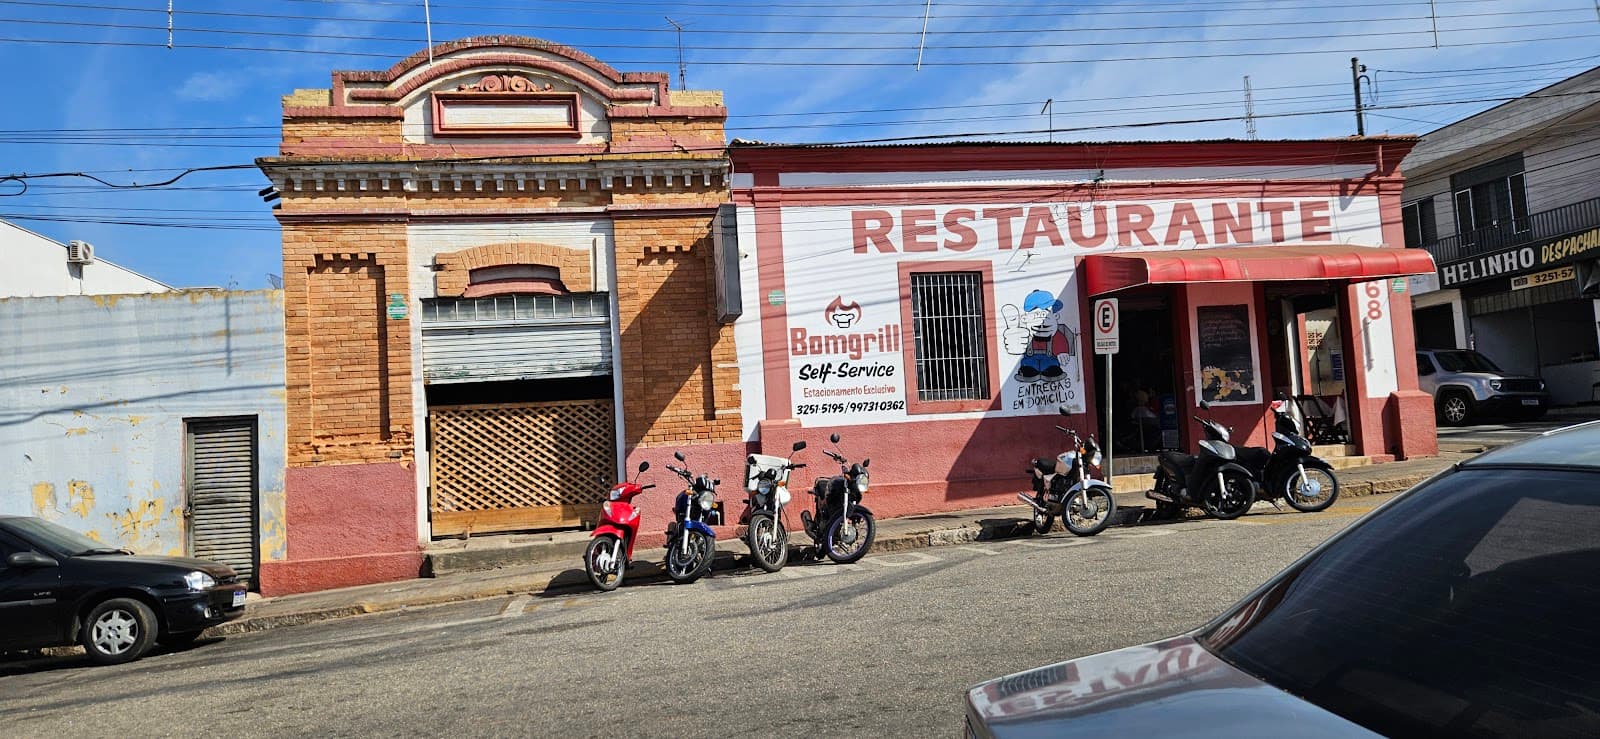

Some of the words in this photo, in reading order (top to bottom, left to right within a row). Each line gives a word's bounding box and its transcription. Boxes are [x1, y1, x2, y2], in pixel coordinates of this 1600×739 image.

[851, 201, 1332, 254] RESTAURANTE
[1442, 247, 1535, 286] HELINHO
[1102, 307, 1110, 328] E
[789, 324, 900, 360] Bomgrill
[798, 361, 895, 384] Self-Service
[803, 387, 863, 398] Estacionamento
[863, 384, 896, 395] Exclusivo
[1017, 377, 1072, 398] ENTREGAS
[1013, 399, 1025, 410] EM
[1026, 390, 1075, 409] DOMICILIO
